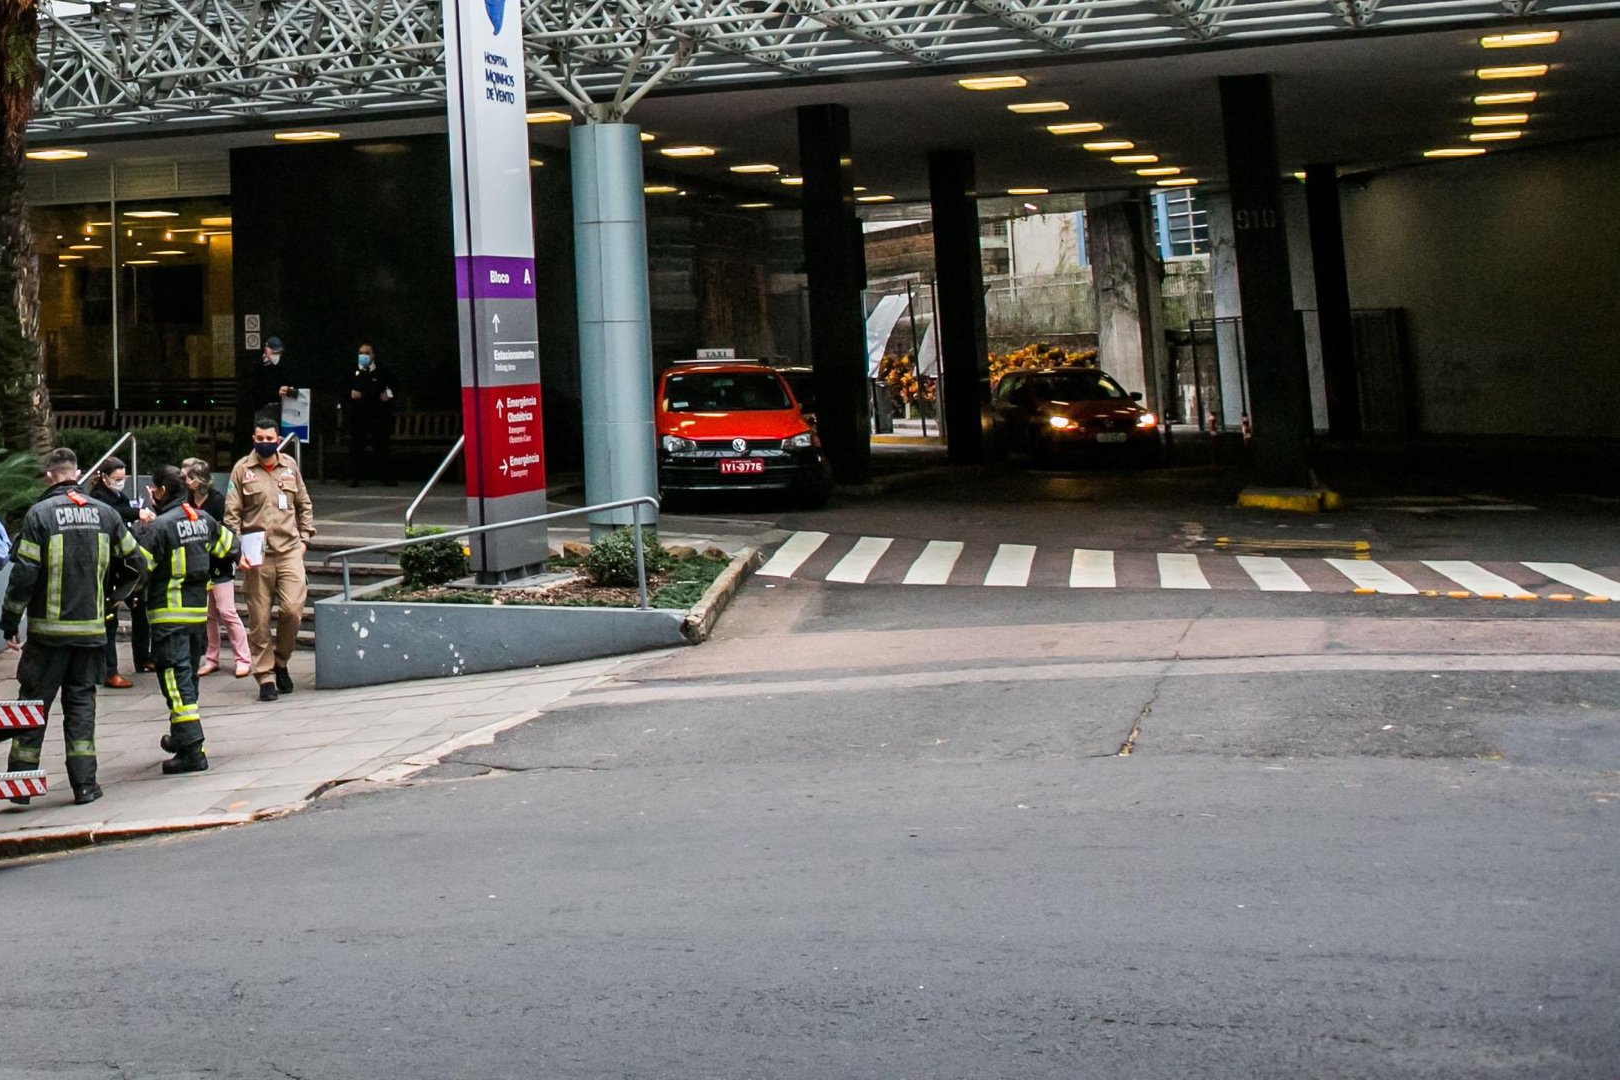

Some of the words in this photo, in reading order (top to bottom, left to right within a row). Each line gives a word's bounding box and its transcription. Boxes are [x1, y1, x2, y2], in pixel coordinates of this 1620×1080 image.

[485, 68, 515, 87] MOINHOS
[486, 87, 494, 100] DE
[493, 82, 515, 105] VENTO
[489, 270, 510, 284] Bloco
[523, 268, 531, 284] A
[55, 507, 100, 525] CBMRS
